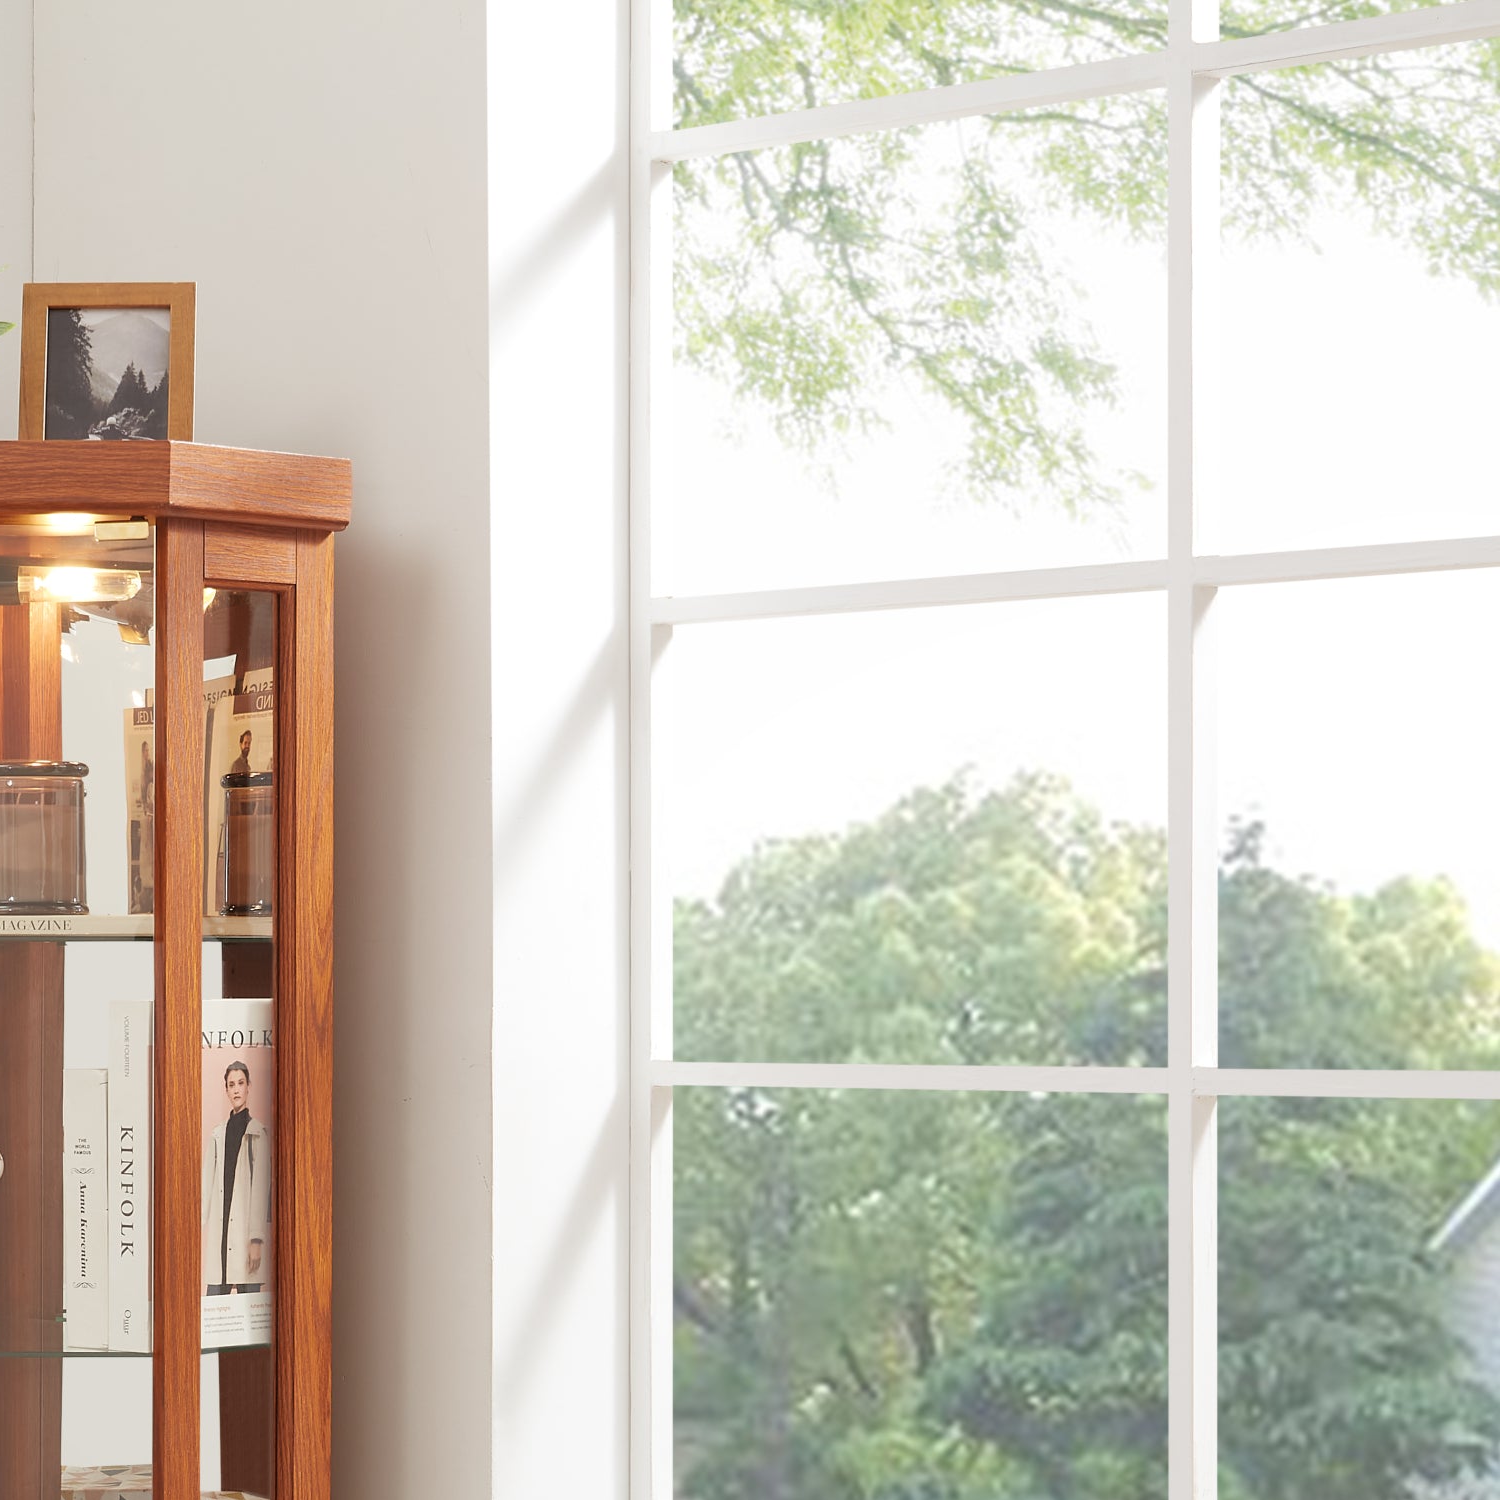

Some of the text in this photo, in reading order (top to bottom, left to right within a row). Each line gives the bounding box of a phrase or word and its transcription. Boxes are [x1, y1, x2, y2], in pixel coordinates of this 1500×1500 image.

[79, 1181, 88, 1277] Anna Karenina
[120, 1125, 134, 1257] KINFOLK
